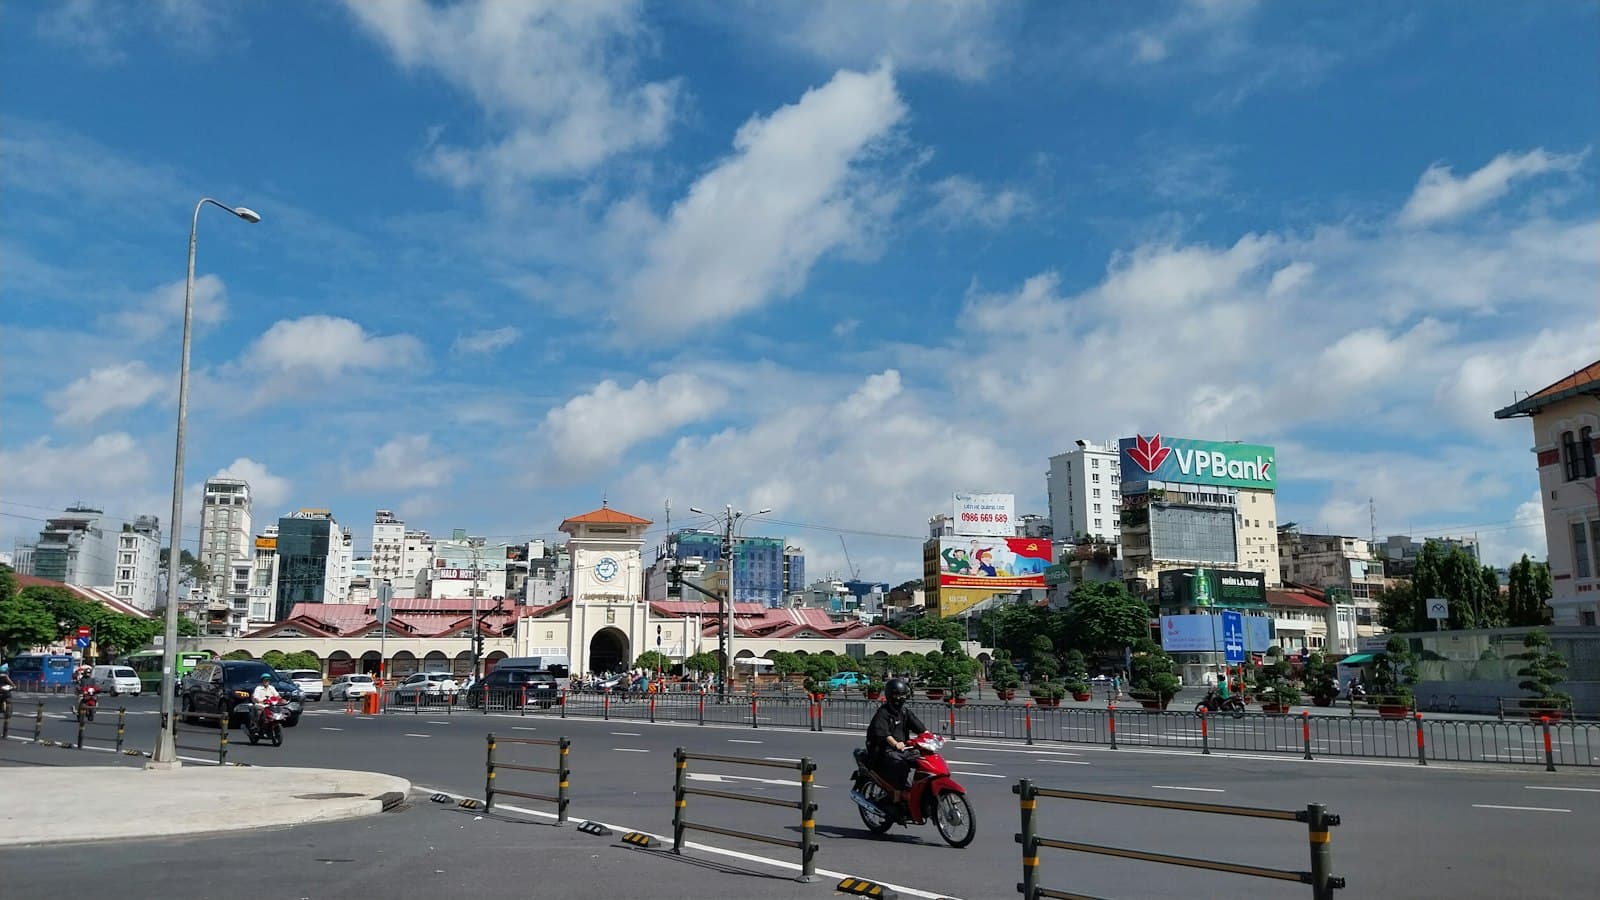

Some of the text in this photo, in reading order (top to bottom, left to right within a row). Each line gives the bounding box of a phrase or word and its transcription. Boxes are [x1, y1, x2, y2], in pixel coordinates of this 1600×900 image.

[1105, 439, 1119, 452] LIB
[1174, 448, 1272, 481] VPBank
[962, 512, 1008, 523] 0986 669 689
[440, 570, 456, 578] HALO
